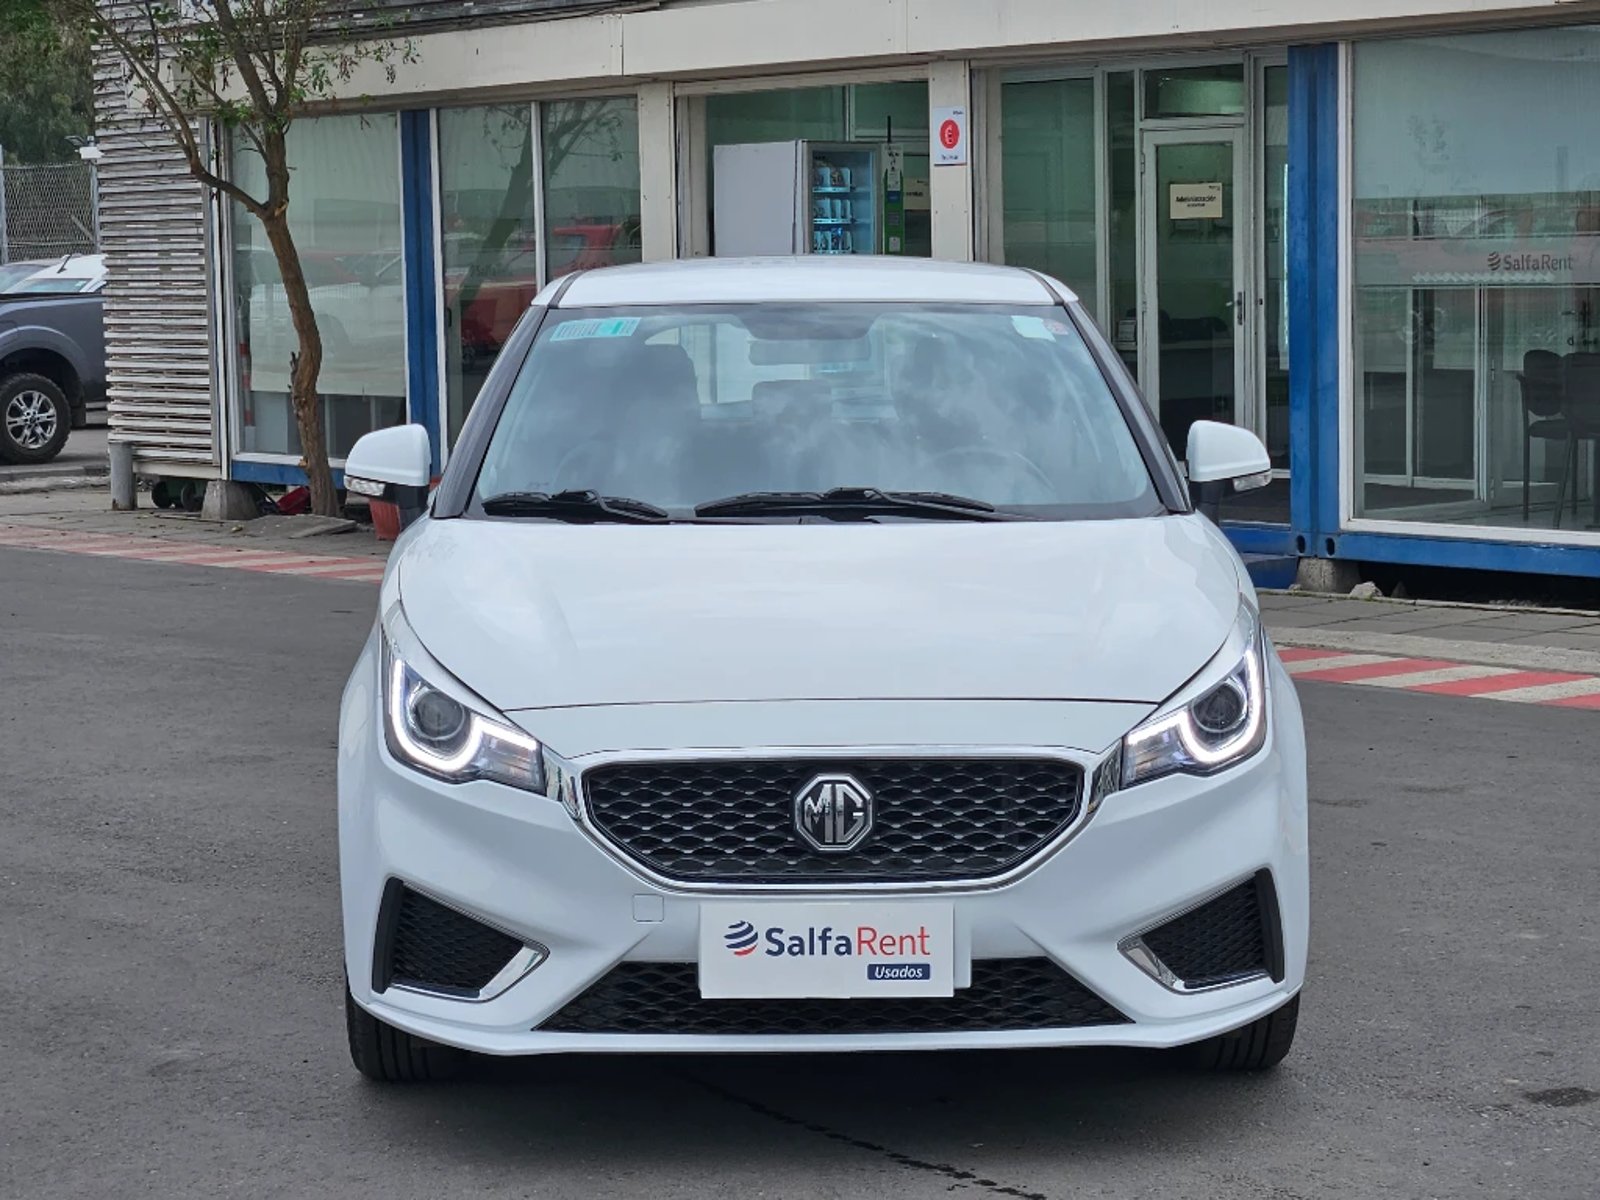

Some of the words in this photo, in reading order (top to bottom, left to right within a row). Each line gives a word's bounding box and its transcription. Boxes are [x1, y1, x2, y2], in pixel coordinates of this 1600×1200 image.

[1503, 254, 1574, 271] SalfaRent
[804, 784, 865, 843] MG
[765, 926, 930, 957] SalfaRent
[874, 966, 923, 979] Usados
